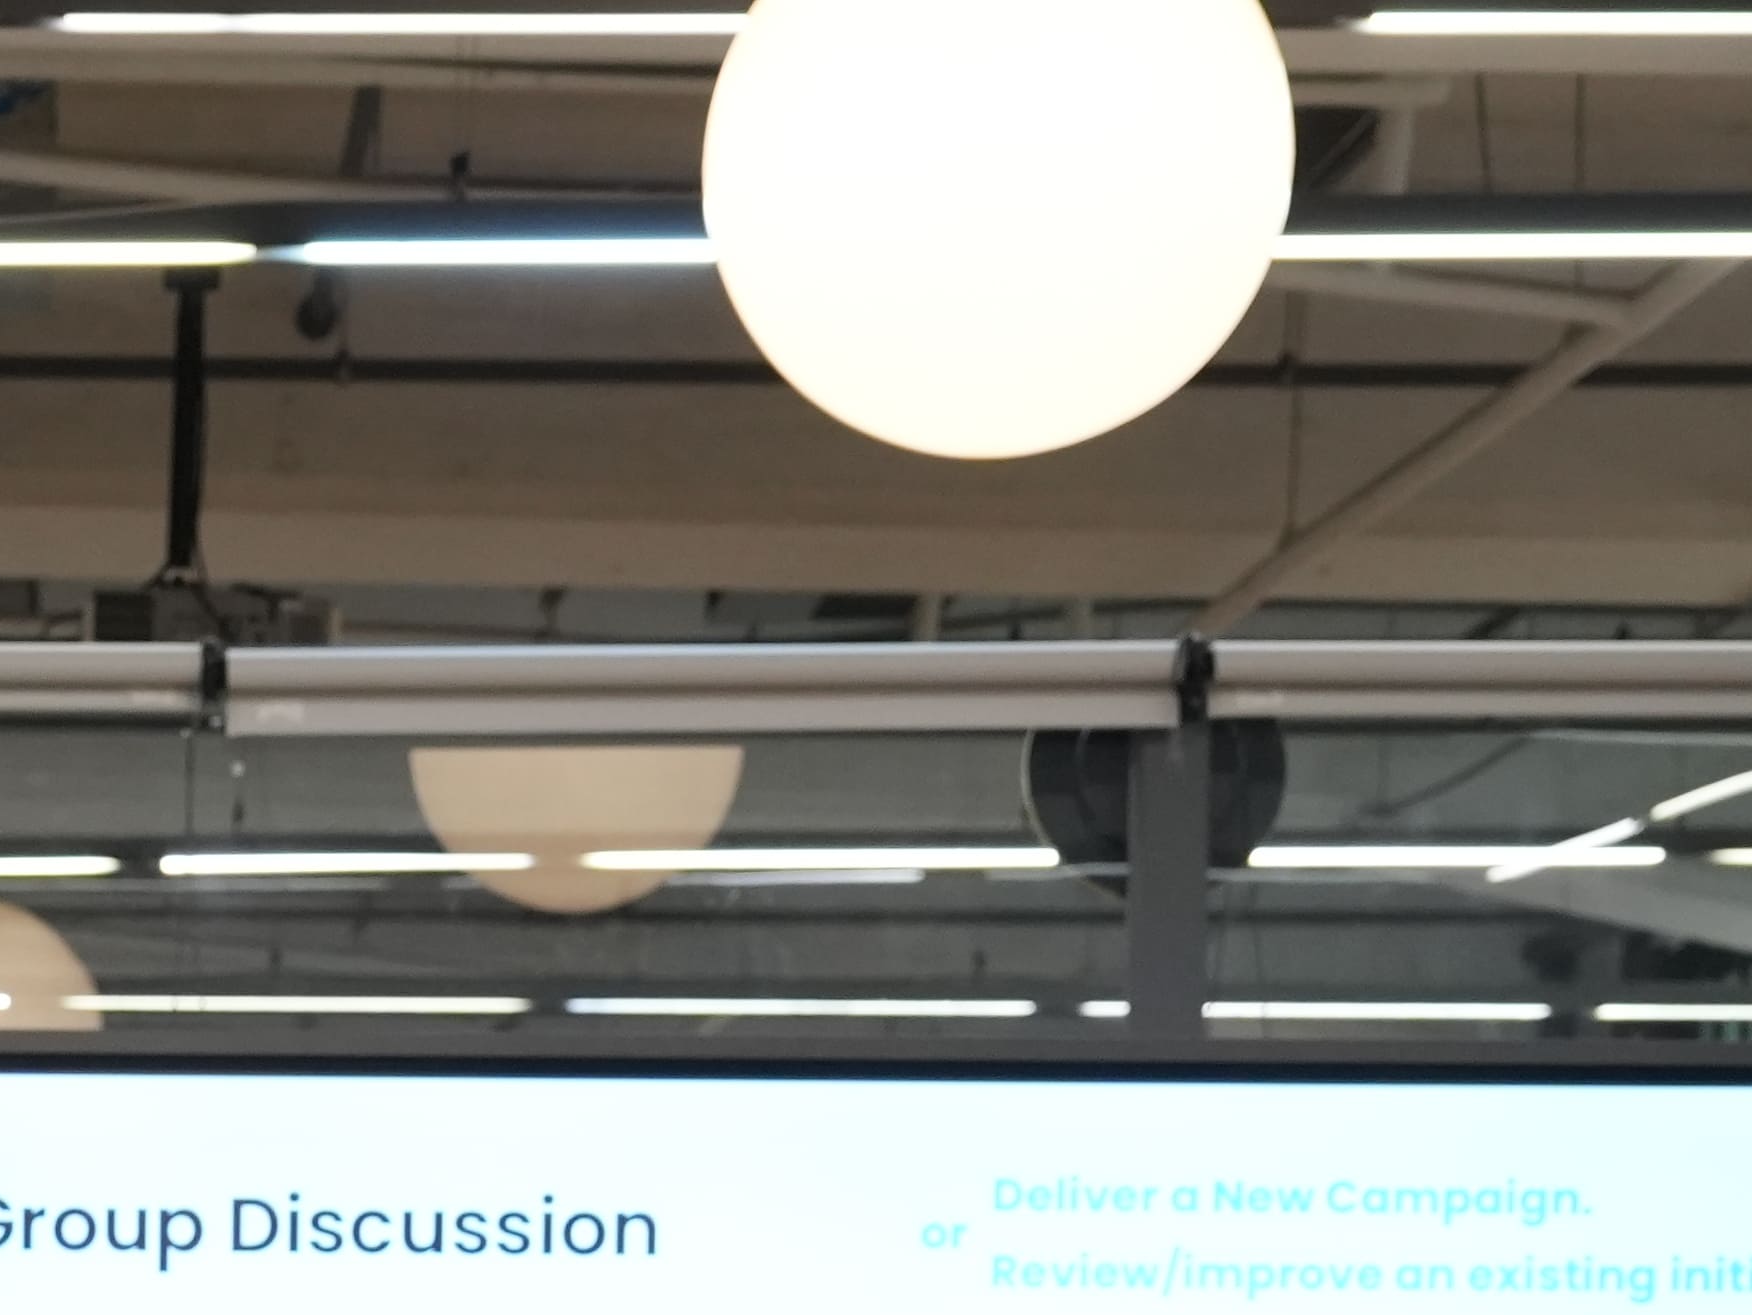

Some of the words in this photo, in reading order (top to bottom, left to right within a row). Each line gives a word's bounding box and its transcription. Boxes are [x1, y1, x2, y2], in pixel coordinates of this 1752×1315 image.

[231, 1191, 657, 1257] Discussion
[992, 1174, 1160, 1214] Deliver
[1169, 1184, 1201, 1215] a
[1211, 1178, 1317, 1215] New
[1324, 1176, 1595, 1230] Campaign.
[918, 1220, 971, 1251] or
[990, 1245, 1385, 1303] Review/improve
[1394, 1263, 1457, 1292] an
[1466, 1253, 1659, 1307] existing
